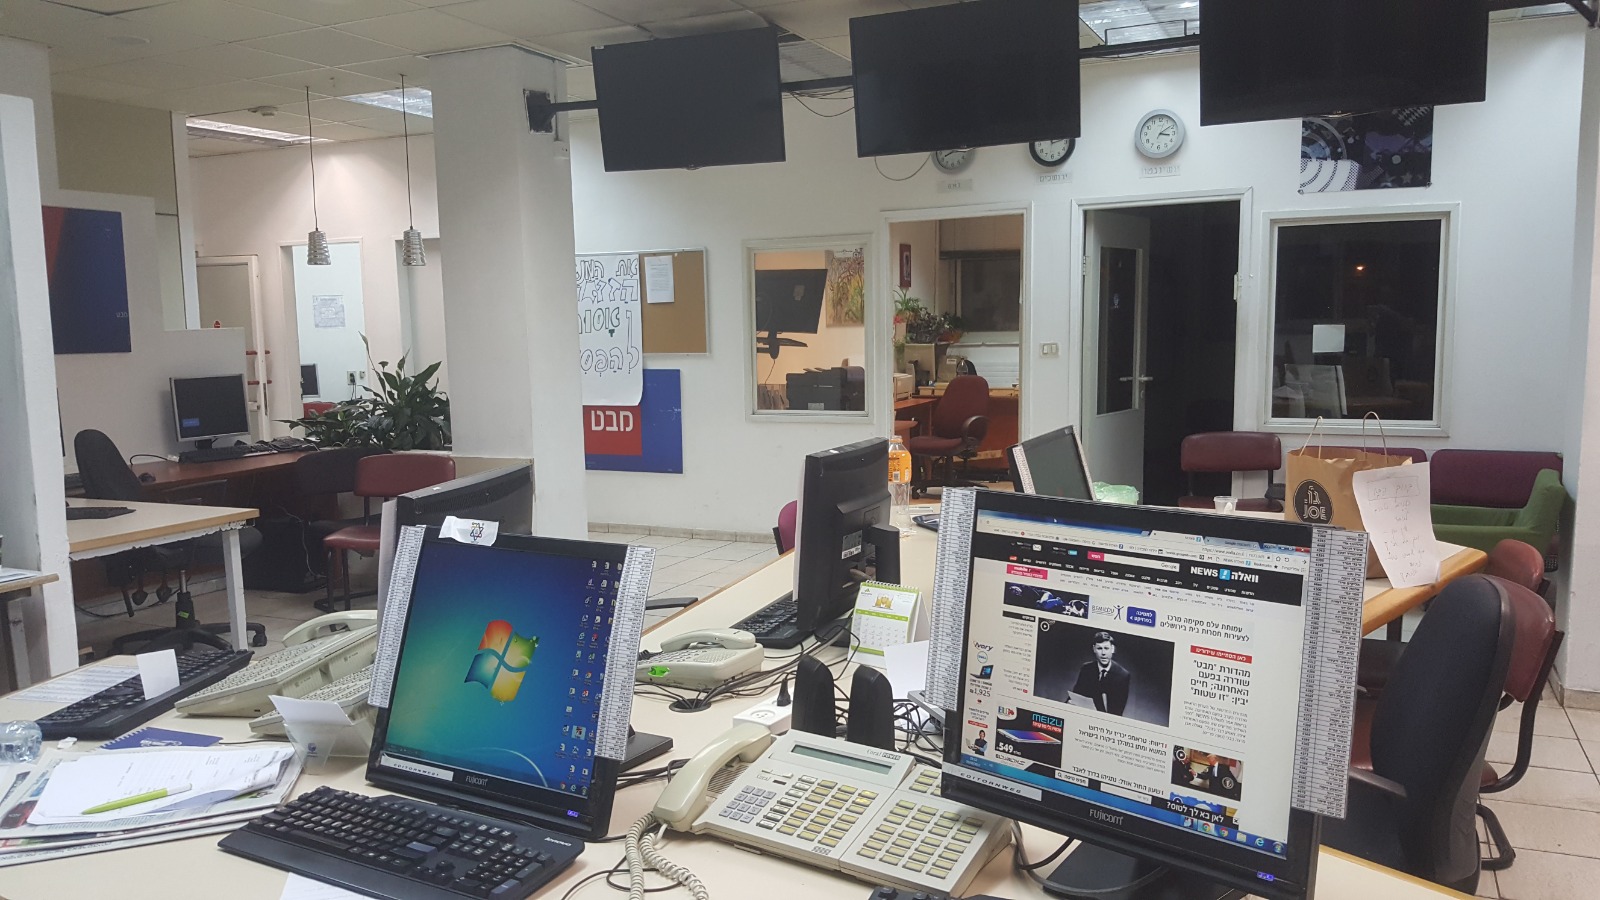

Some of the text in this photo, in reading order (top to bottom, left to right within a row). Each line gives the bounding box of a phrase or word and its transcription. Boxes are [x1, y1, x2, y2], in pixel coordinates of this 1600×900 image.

[590, 410, 634, 432] מבט
[1303, 501, 1328, 520] JOE
[1190, 566, 1219, 578] NEWS
[1160, 621, 1187, 631] בירושלים
[1206, 620, 1220, 628] עלם
[1221, 623, 1243, 632] עמותת
[1224, 632, 1250, 642] לצעירות
[1219, 665, 1251, 678] מהדורת
[1190, 678, 1208, 688] חיים
[1198, 670, 1250, 687] שודרה בפעם
[1032, 713, 1063, 727] MEIZU
[998, 742, 1014, 753] 549
[1166, 801, 1224, 823] לאן בא לך לטוס?
